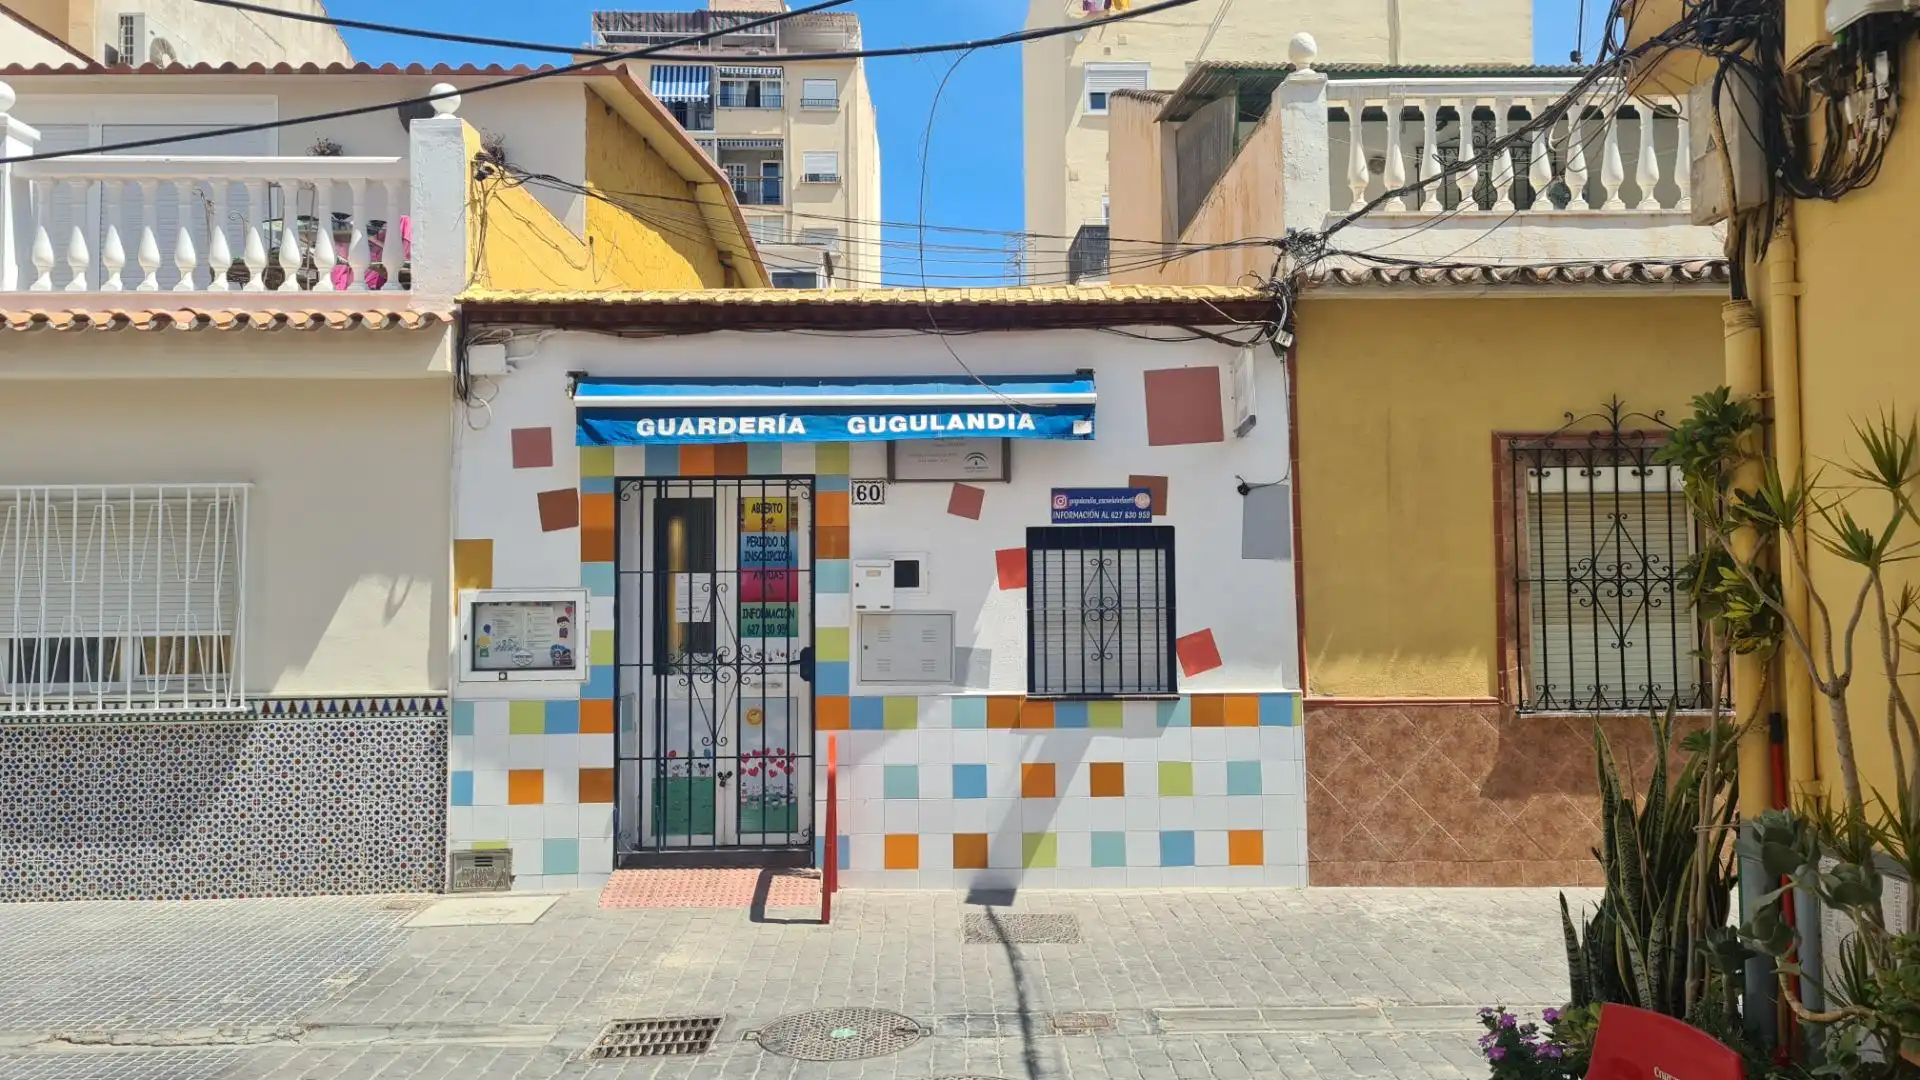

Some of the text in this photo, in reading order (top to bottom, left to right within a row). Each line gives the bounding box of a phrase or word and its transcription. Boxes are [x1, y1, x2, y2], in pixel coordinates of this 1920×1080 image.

[636, 413, 1036, 436] GUARDERÍA GUGULANDIA
[856, 485, 880, 501] 60
[1101, 511, 1110, 519] AL
[752, 570, 785, 581] AYDAS
